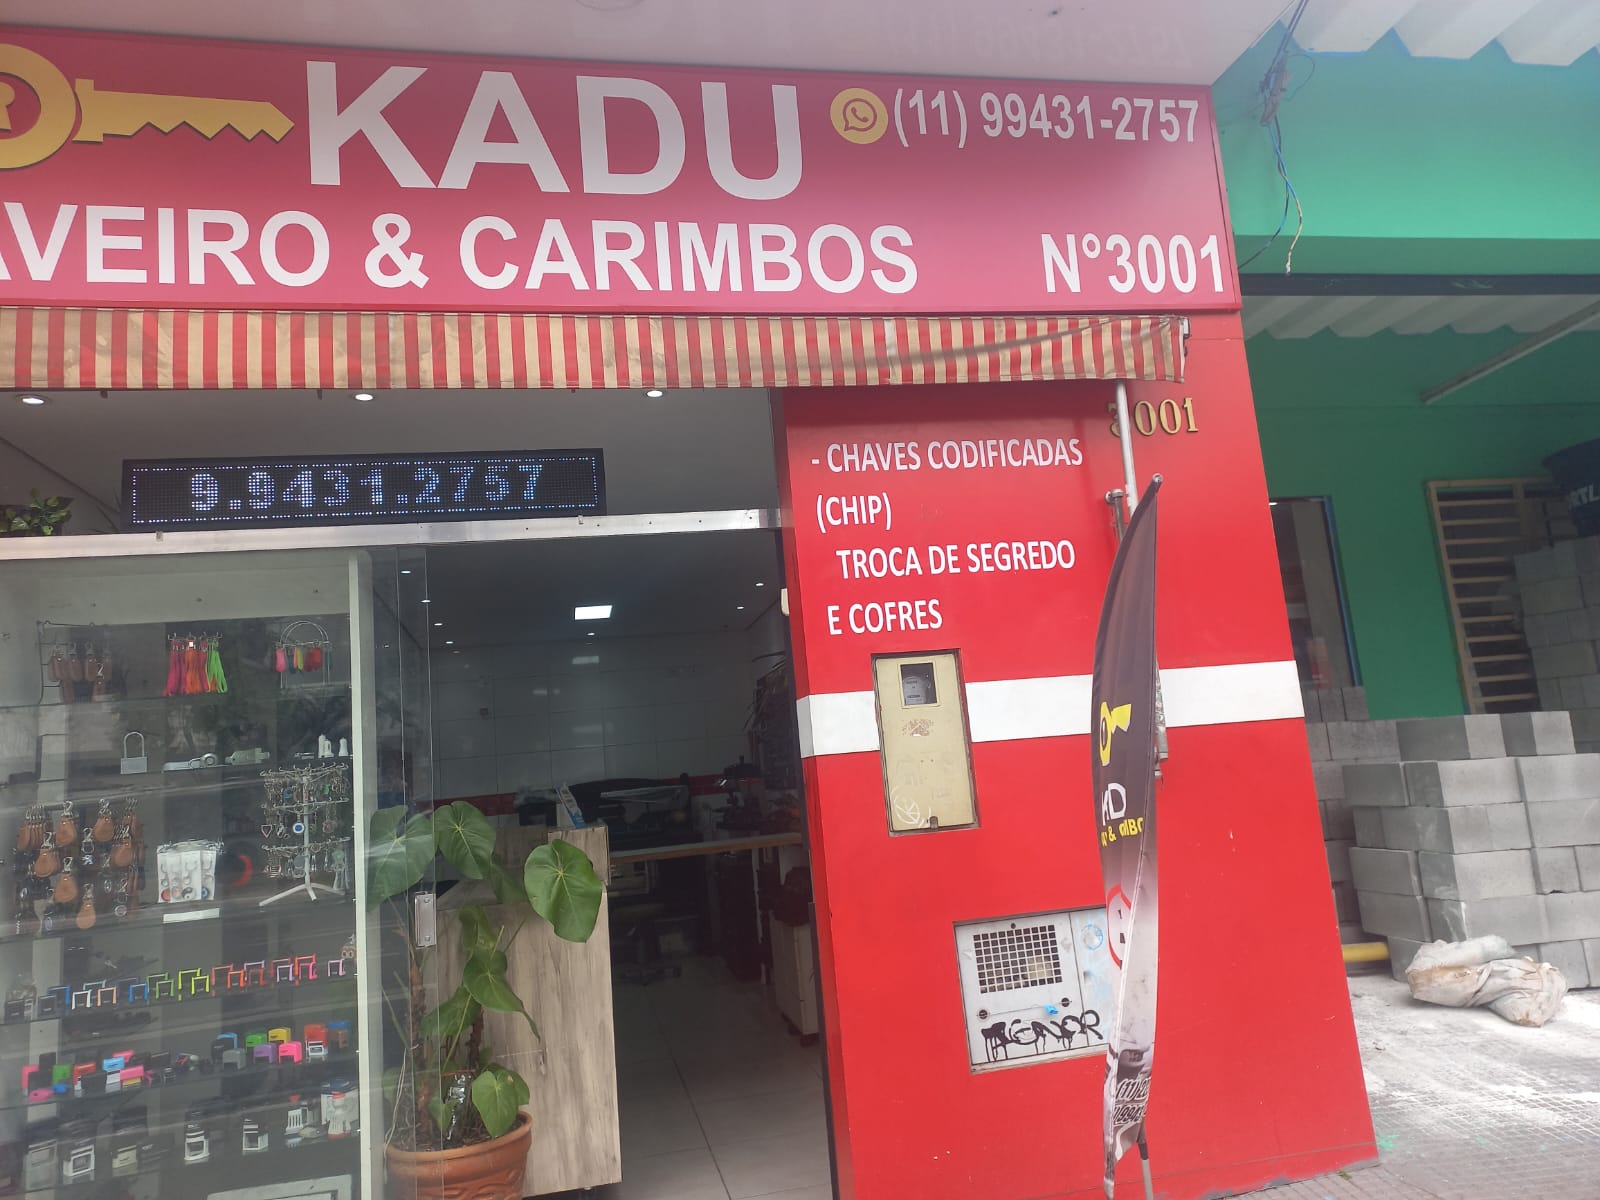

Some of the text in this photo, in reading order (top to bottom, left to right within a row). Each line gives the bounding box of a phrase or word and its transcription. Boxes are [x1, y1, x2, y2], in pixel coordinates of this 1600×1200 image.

[306, 60, 803, 201] KADU
[894, 88, 1199, 148] (11) 99431-2757
[364, 212, 430, 289] &
[458, 215, 919, 295] CARIMBOS
[826, 441, 922, 474] CHAVES
[927, 437, 1083, 470] CODIFICADAS
[190, 465, 543, 511] 9.9431.2757
[816, 492, 893, 534] (CHIP)
[836, 539, 1076, 580] TROCA DE SEGREDO
[827, 598, 944, 635] E COFRES
